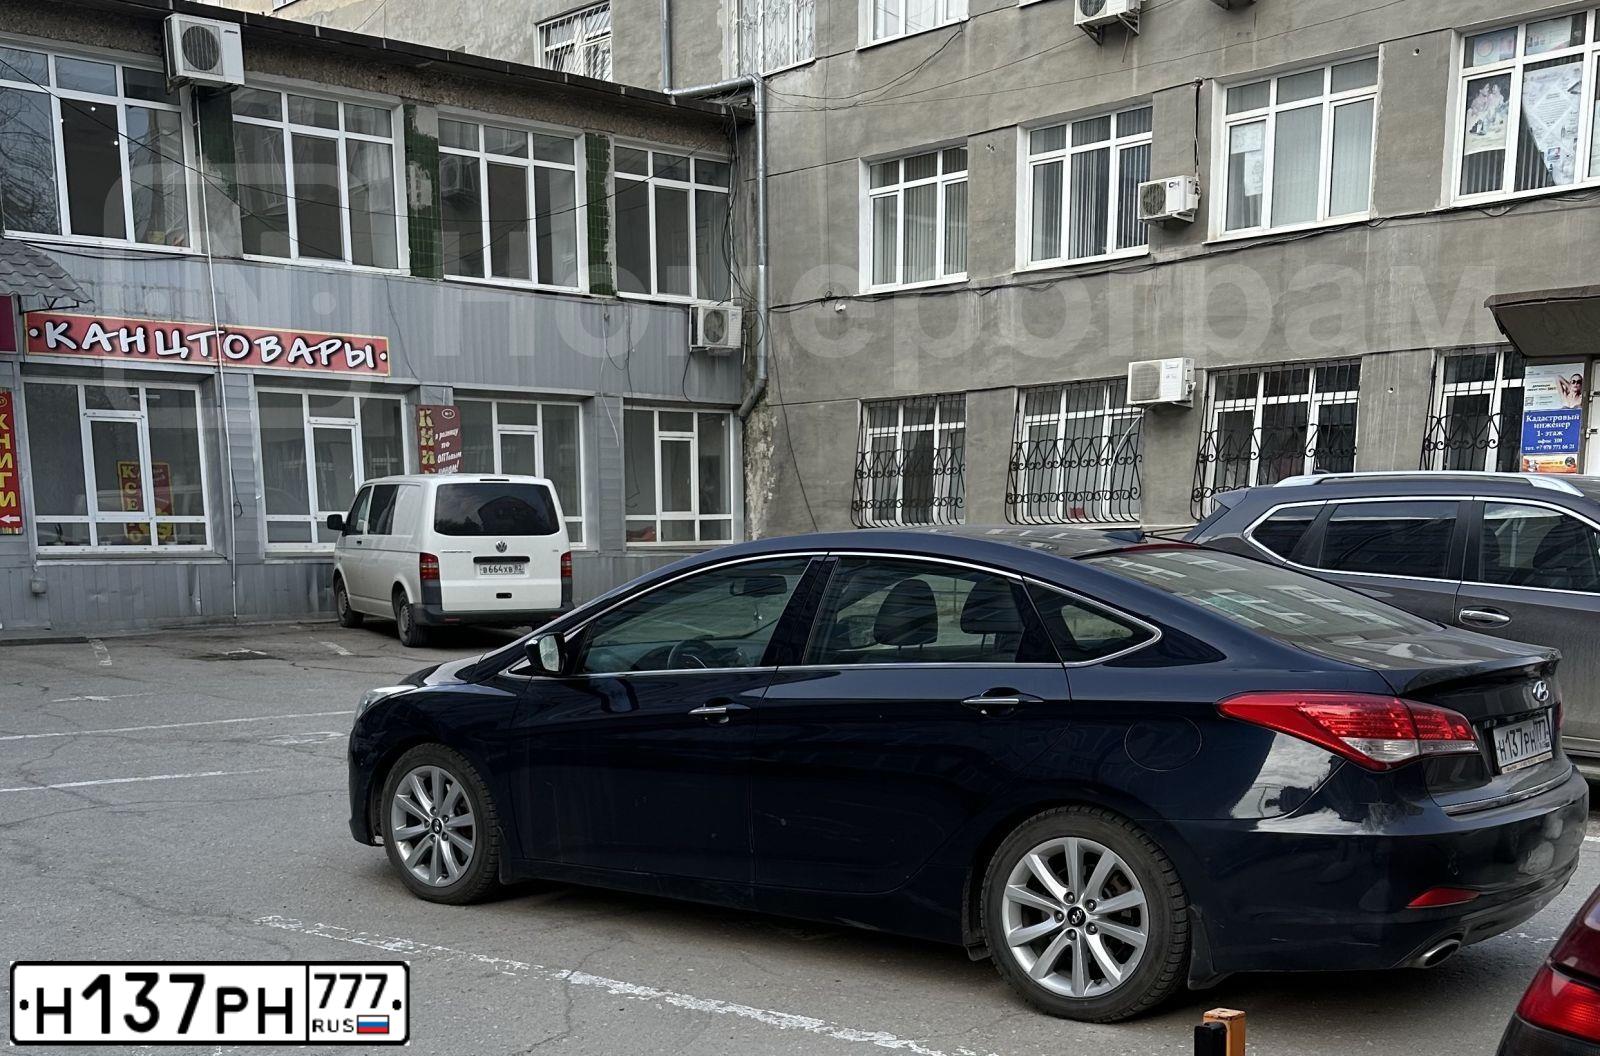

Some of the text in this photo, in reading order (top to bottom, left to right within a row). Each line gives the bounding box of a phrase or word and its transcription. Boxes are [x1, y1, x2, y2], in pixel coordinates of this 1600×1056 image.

[44, 320, 375, 369] КАНЦТОВАРЫ
[1526, 414, 1580, 423] Кадастровый
[1498, 728, 1537, 761] Н137РН
